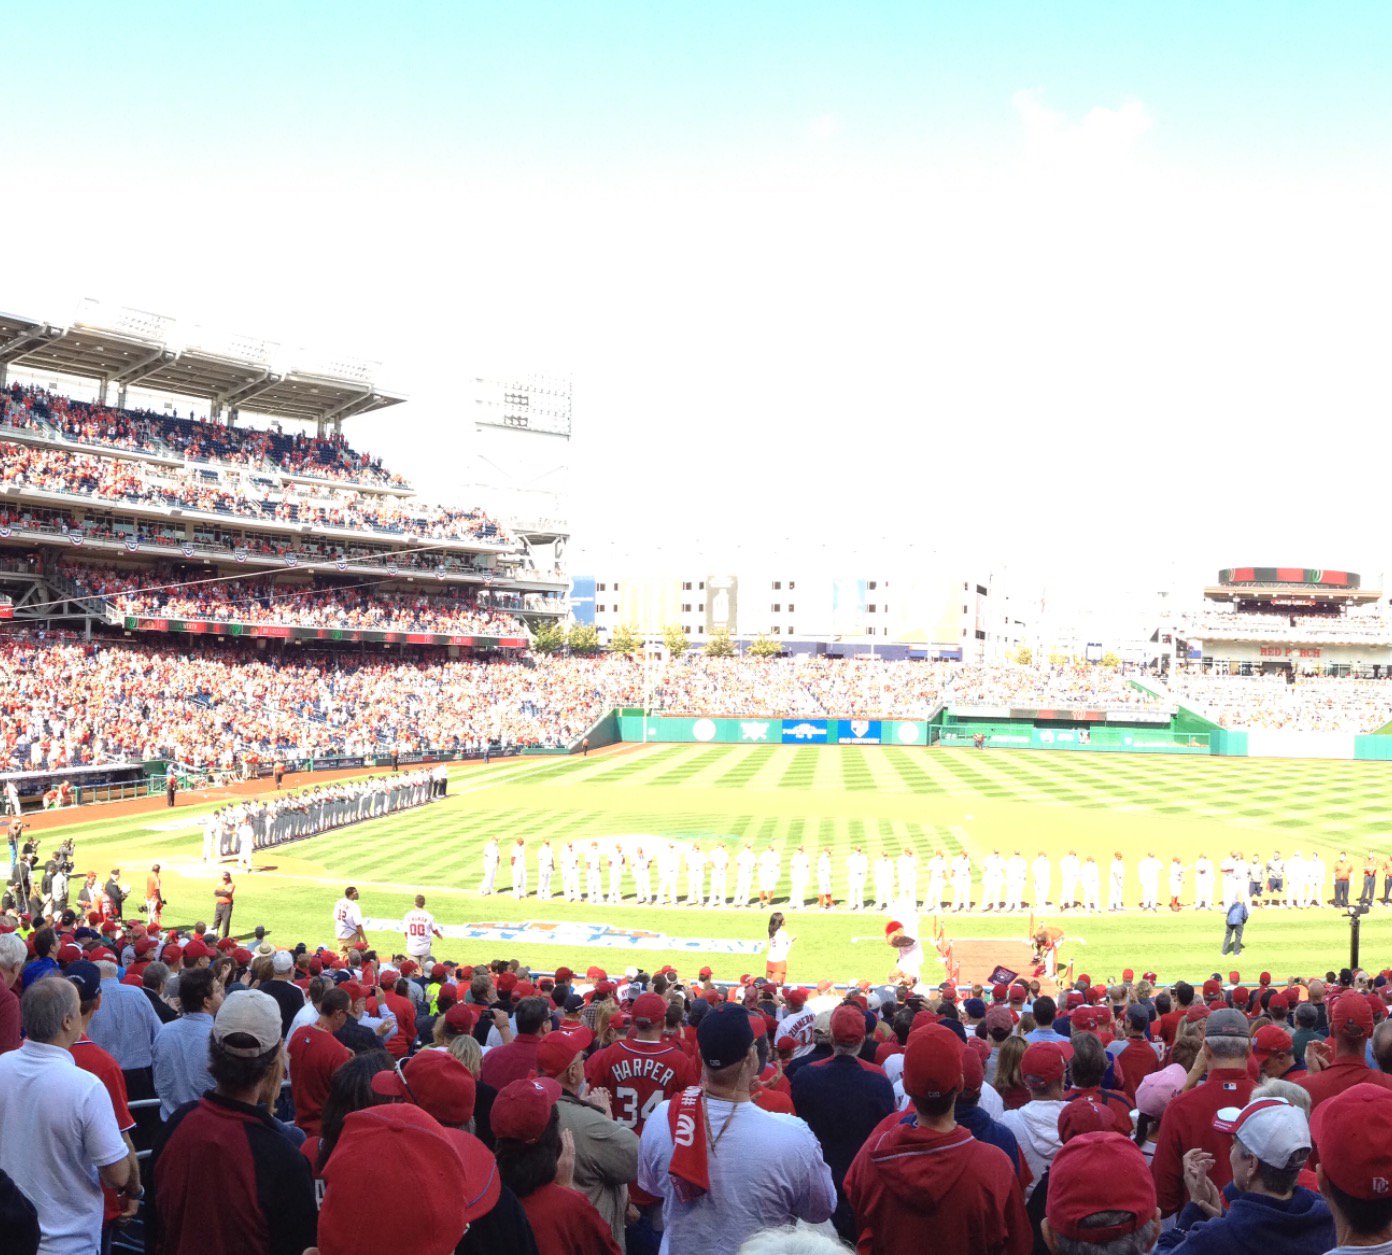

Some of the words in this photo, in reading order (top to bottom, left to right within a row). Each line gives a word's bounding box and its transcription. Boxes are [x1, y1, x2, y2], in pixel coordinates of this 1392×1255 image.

[1260, 647, 1282, 658] RED
[1285, 647, 1321, 658] PRCH
[409, 924, 426, 937] 00
[611, 1058, 675, 1087] HARPER
[615, 1085, 665, 1130] 34
